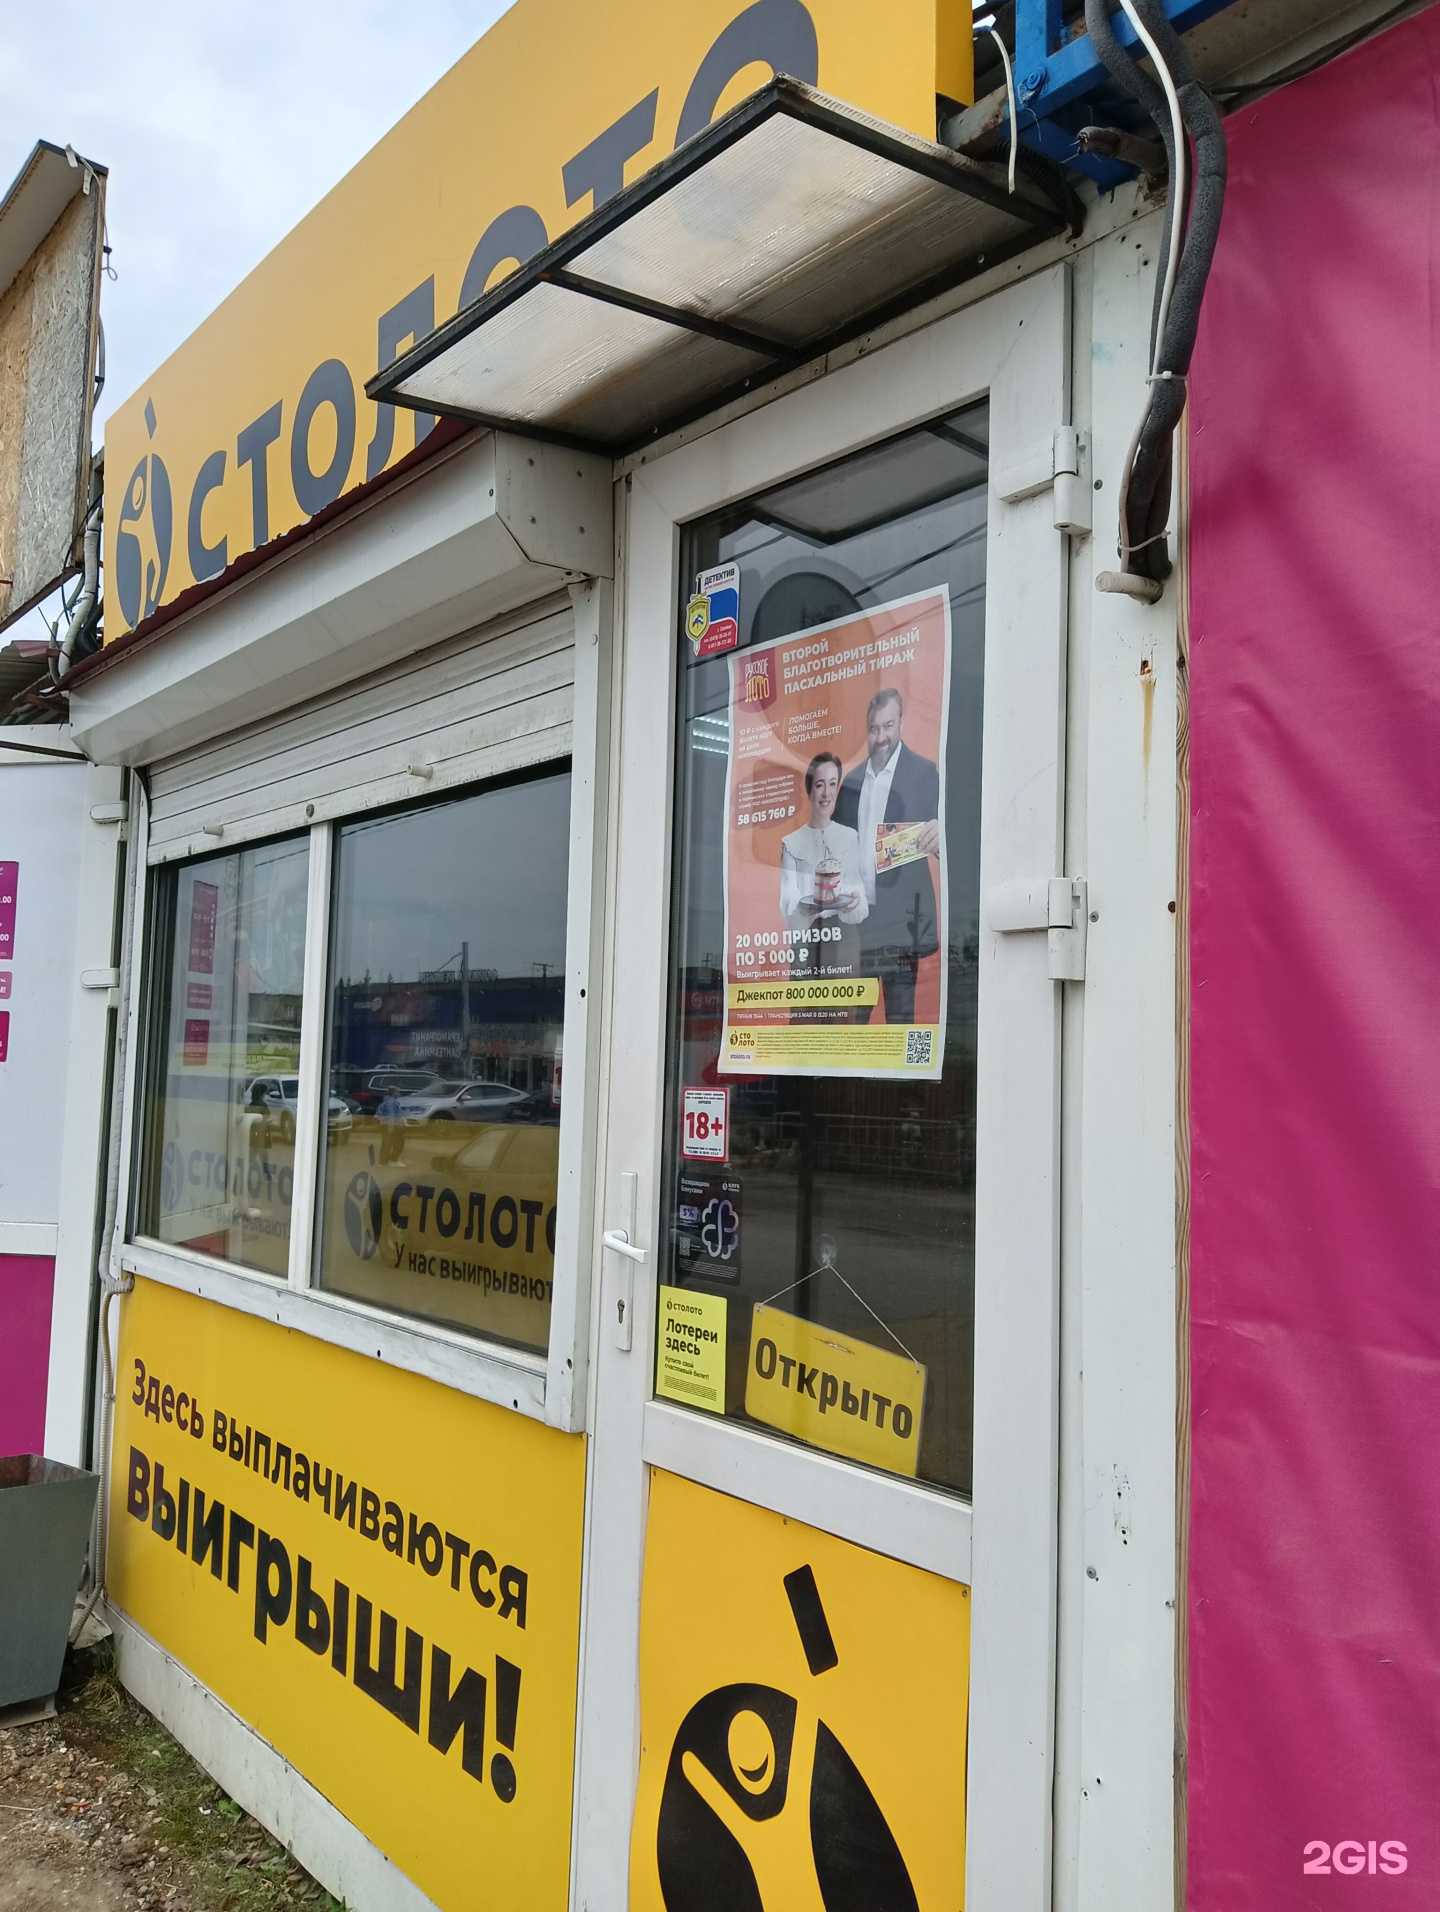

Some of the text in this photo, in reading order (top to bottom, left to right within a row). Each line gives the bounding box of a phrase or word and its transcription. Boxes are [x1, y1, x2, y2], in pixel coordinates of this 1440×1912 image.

[704, 568, 735, 586] ДЕТЕКТИВ
[782, 640, 829, 663] ВТОРОЙ
[783, 627, 920, 679] БЛАГОТВОРИТЕЛЬНЫЙ
[784, 649, 917, 695] ПАСХАЛЬНЫЙ ТИРАЖ
[745, 674, 770, 703] ЛОТО
[788, 709, 828, 725] ПОМОГАЕМ
[788, 725, 842, 744] КОГДА ВМЕСТЕ!
[738, 814, 750, 825] 58
[752, 811, 766, 822] 615
[768, 807, 785, 819] 760
[736, 926, 842, 948] 20 000 ПРИЗОВ
[736, 951, 754, 966] ПО
[758, 951, 766, 964] 5
[769, 949, 795, 963] 000
[736, 964, 853, 979] Выигрывает каждый 2-й билет!
[737, 989, 783, 1003] Джекпот
[786, 988, 805, 999] 800
[808, 986, 829, 998] 000
[832, 985, 854, 997] 000
[738, 1039, 755, 1047] ЛОТО
[739, 1032, 751, 1040] СТО
[686, 1112, 722, 1140] 18+
[394, 1241, 554, 1303] У нас выигрывают
[673, 1301, 703, 1315] СТОЛОТО
[666, 1318, 718, 1344] Лотереи
[665, 1337, 701, 1356] здесь
[755, 1337, 913, 1440] Открыто
[131, 1358, 529, 1630] Здесь выплачиваются
[126, 1445, 522, 1804] выигрыши!
